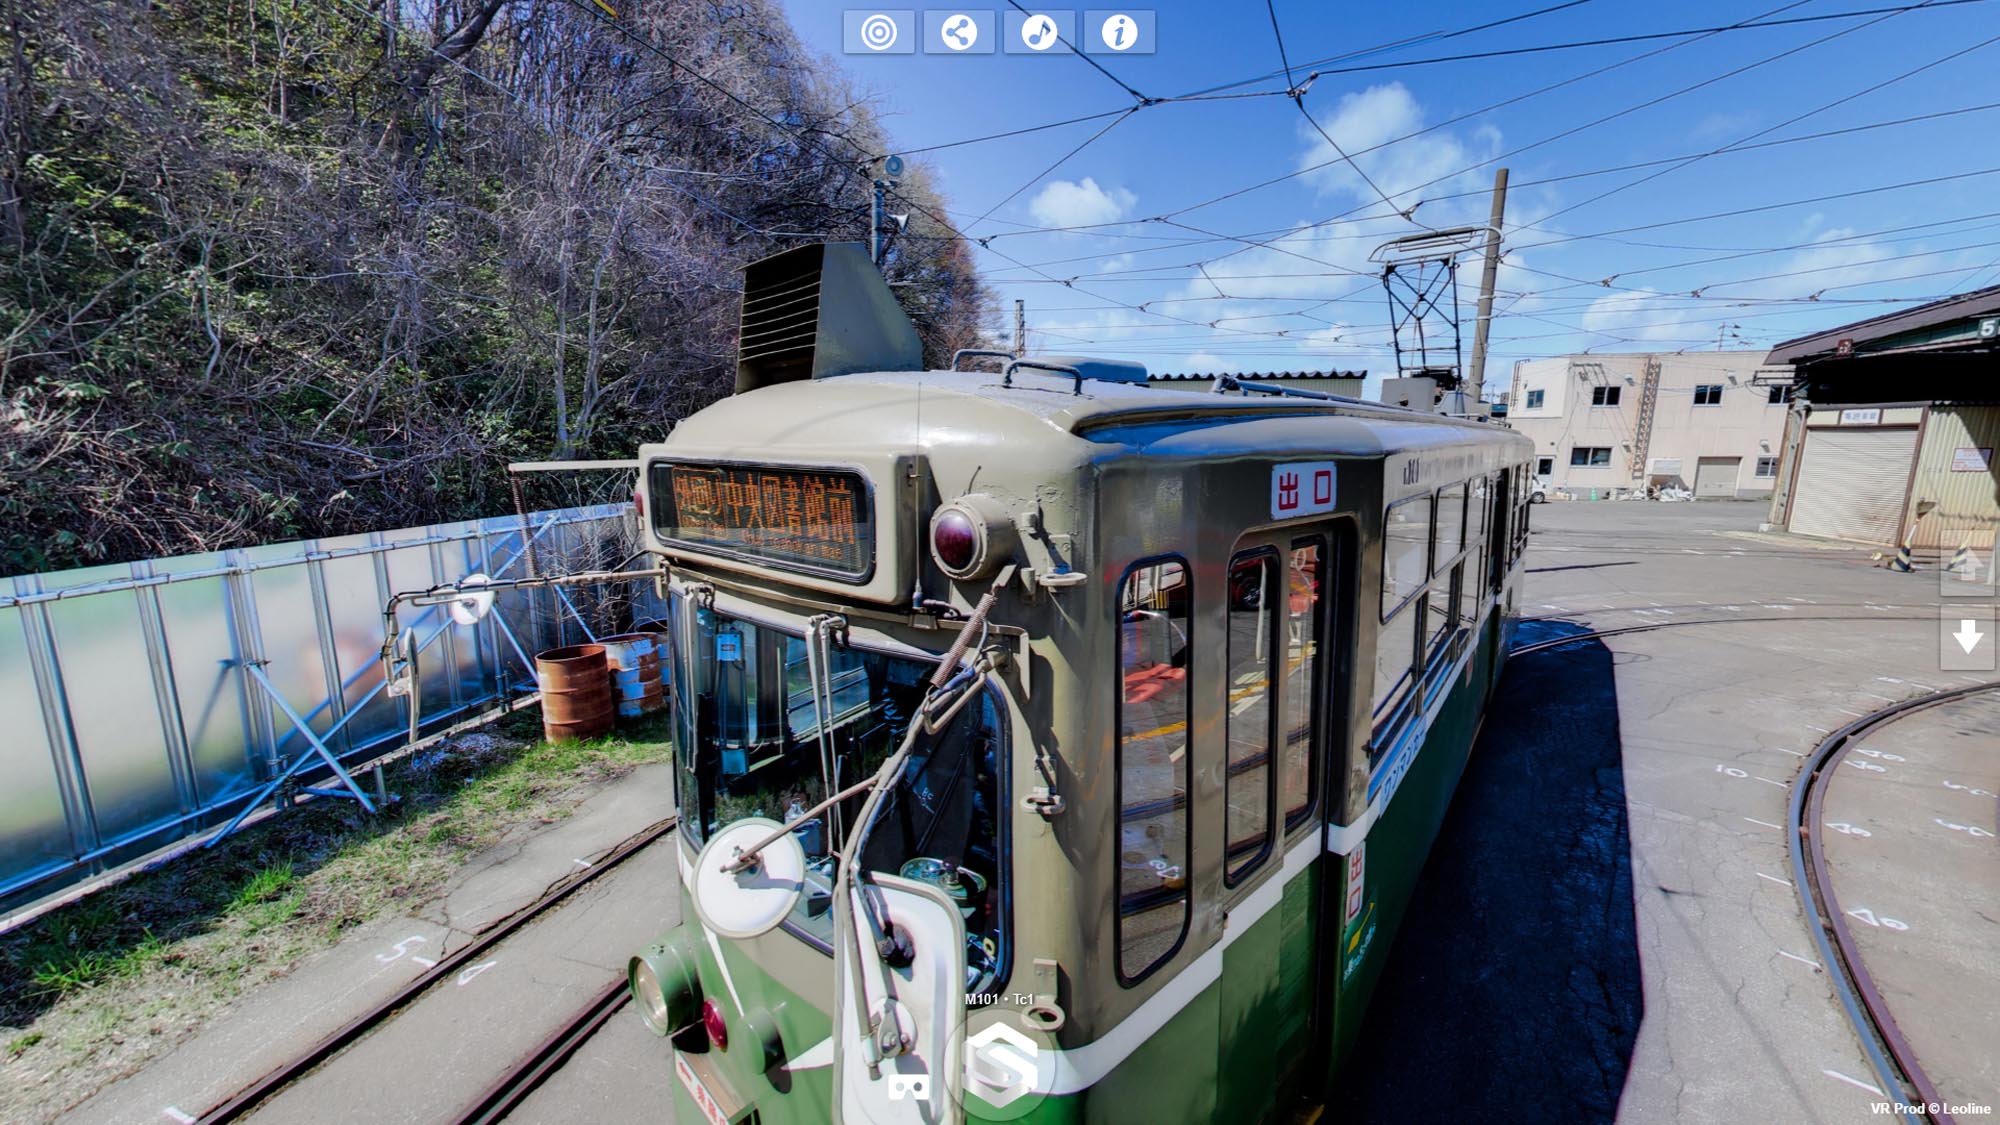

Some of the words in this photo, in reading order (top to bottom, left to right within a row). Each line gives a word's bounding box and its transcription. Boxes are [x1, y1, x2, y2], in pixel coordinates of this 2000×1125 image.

[1981, 320, 1996, 337] 5
[726, 470, 856, 545] 中央図書館前
[1279, 470, 1331, 511] 出口
[1349, 847, 1363, 919] 出口
